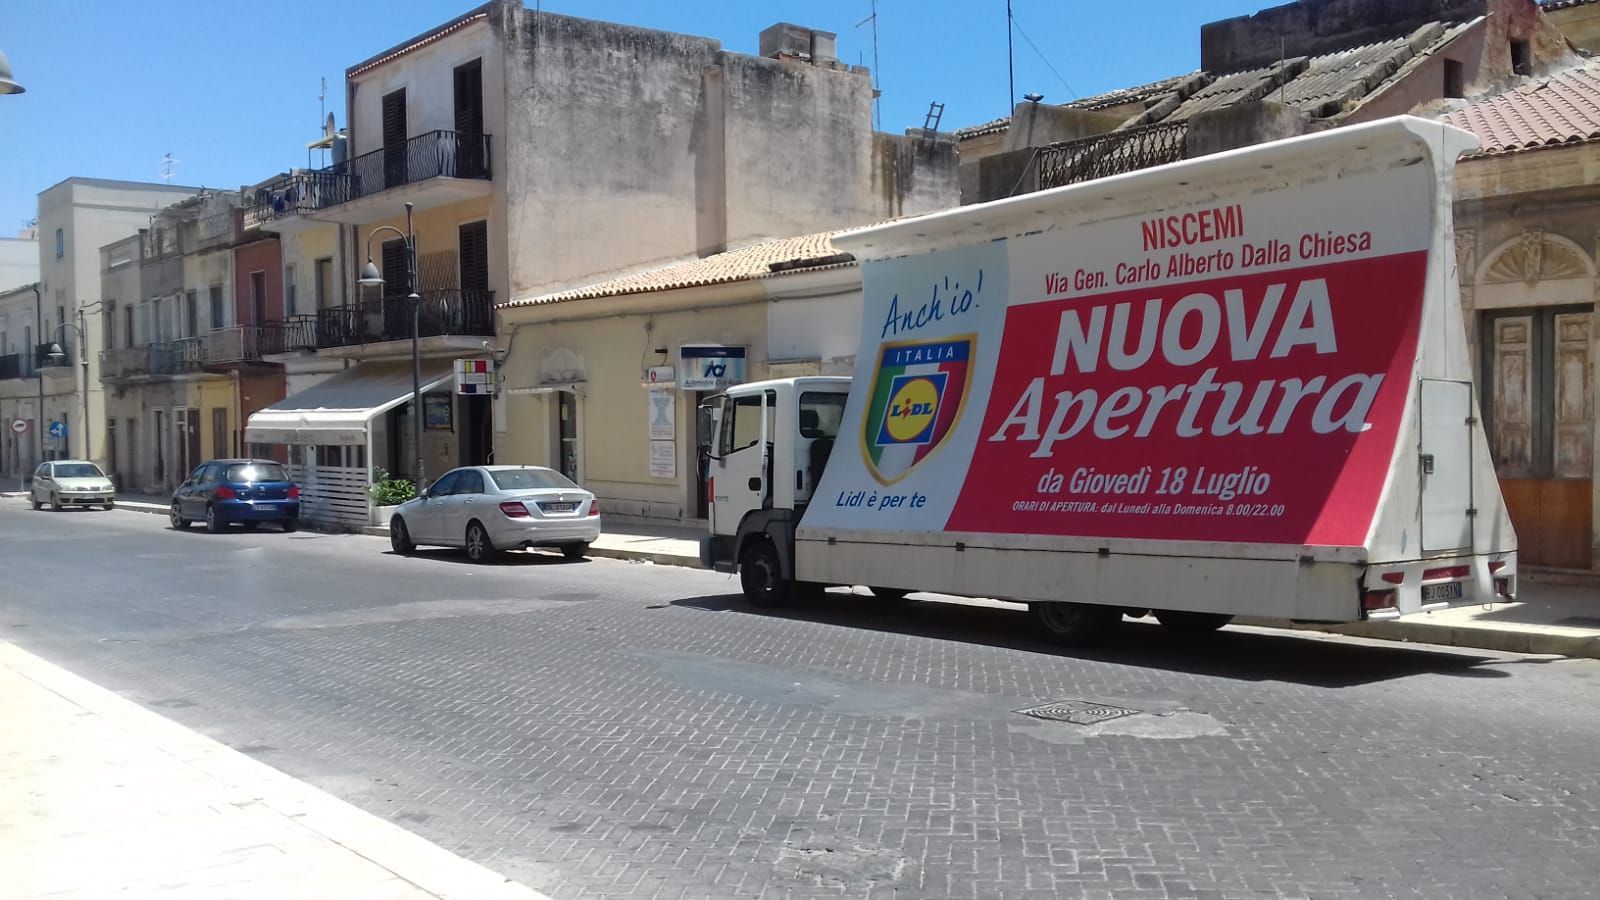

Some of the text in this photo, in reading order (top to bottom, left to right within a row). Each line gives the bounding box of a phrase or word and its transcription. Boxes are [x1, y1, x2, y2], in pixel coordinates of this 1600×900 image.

[1141, 203, 1244, 252] NISCEMI
[1045, 230, 1372, 295] Via Gen. Carlo Alberto Dalla Chiesa
[1049, 277, 1338, 377] NUOVA
[895, 345, 955, 363] ITALIA
[987, 366, 1387, 459] Apertura
[835, 490, 928, 511] Lidl è per te
[1036, 465, 1271, 501] da Giovedì 18 Luglio
[1012, 500, 1039, 512] ORARI
[1039, 501, 1050, 512] DI
[1050, 501, 1100, 514] APERTURA:
[1100, 502, 1117, 514] dal
[1151, 503, 1172, 515] alla
[1173, 503, 1225, 516] Domenica
[1225, 503, 1286, 517] 8.00/22.00
